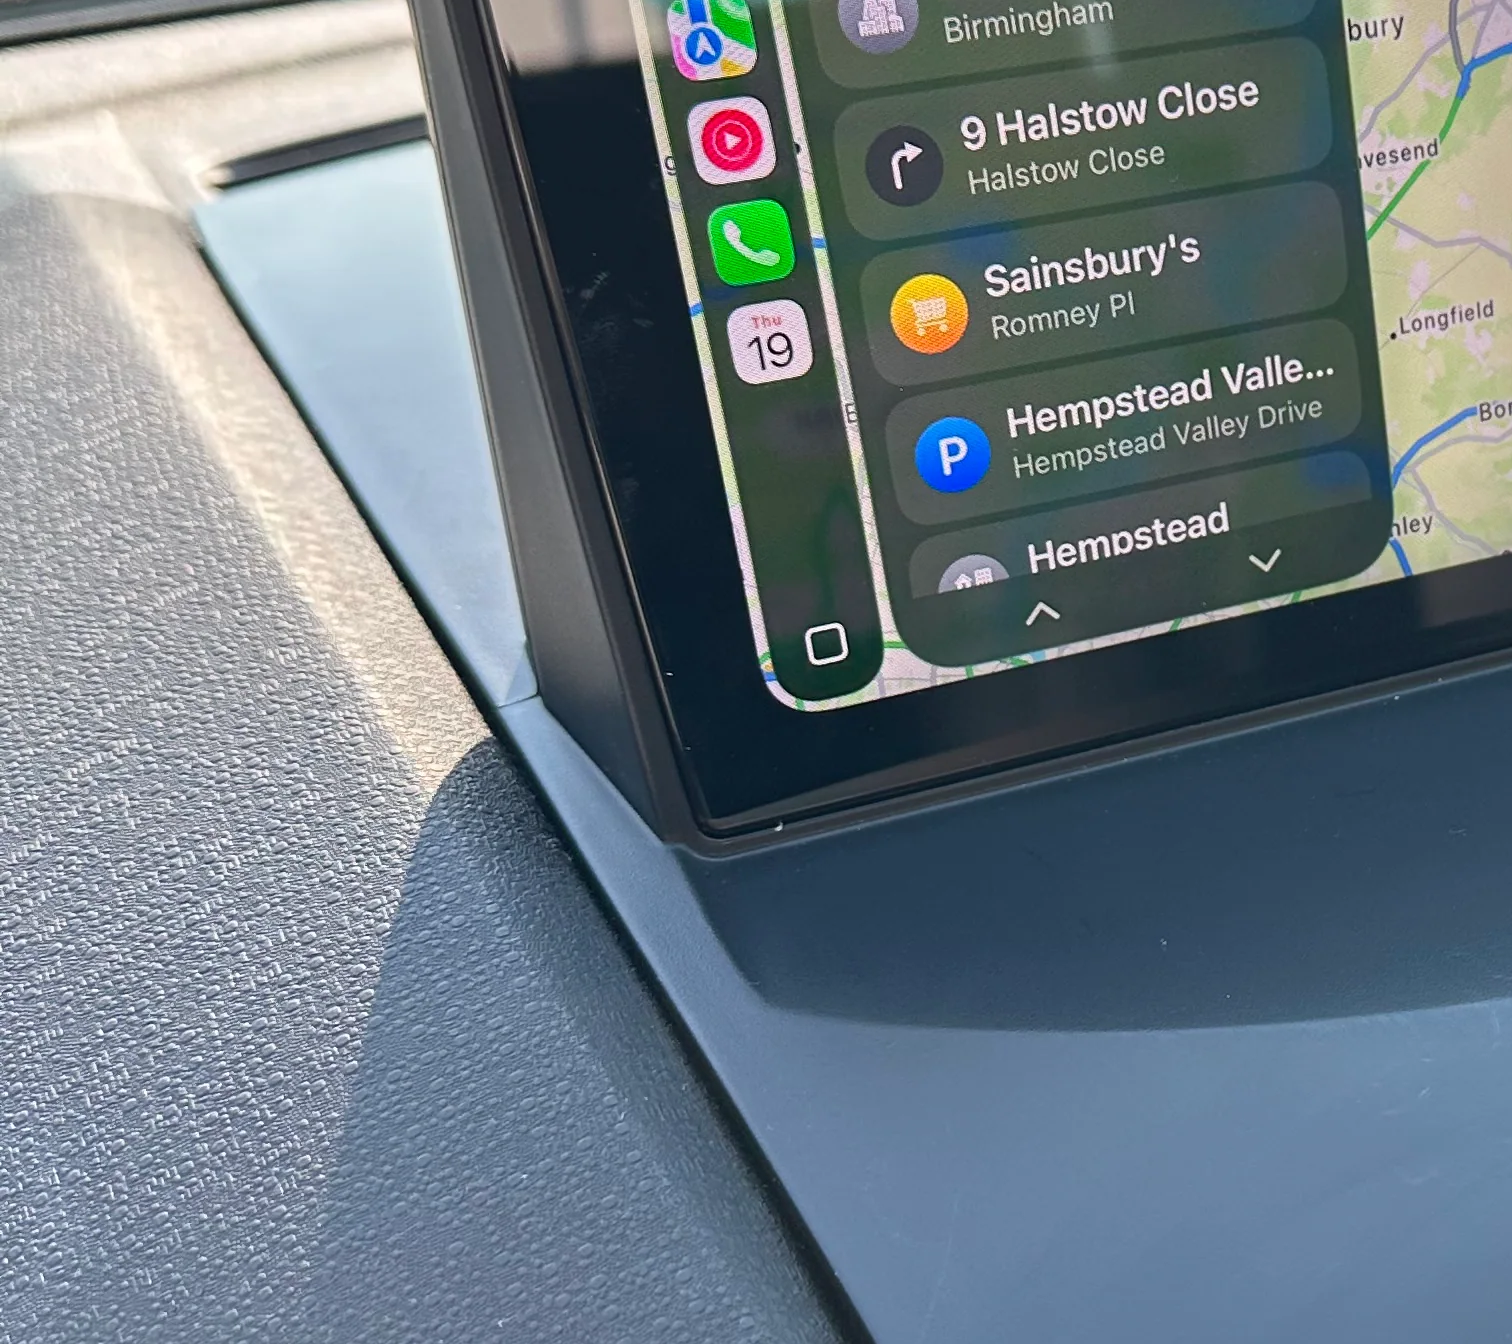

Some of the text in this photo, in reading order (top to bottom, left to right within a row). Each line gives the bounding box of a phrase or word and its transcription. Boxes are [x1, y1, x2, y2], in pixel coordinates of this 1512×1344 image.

[960, 79, 1259, 151] 9 Halstow Close
[968, 143, 1166, 195] Halstow Close
[984, 233, 1201, 299] Sainsbury's
[750, 315, 783, 330] Thu
[992, 292, 1136, 340] Romney Pl
[1399, 299, 1496, 335] Longfield
[747, 332, 793, 370] 19
[1006, 354, 1334, 439] Hempstead Valle...
[938, 435, 969, 476] P
[1013, 395, 1323, 479] Hempstead Valley Drive
[1028, 502, 1230, 574] Hempstead
